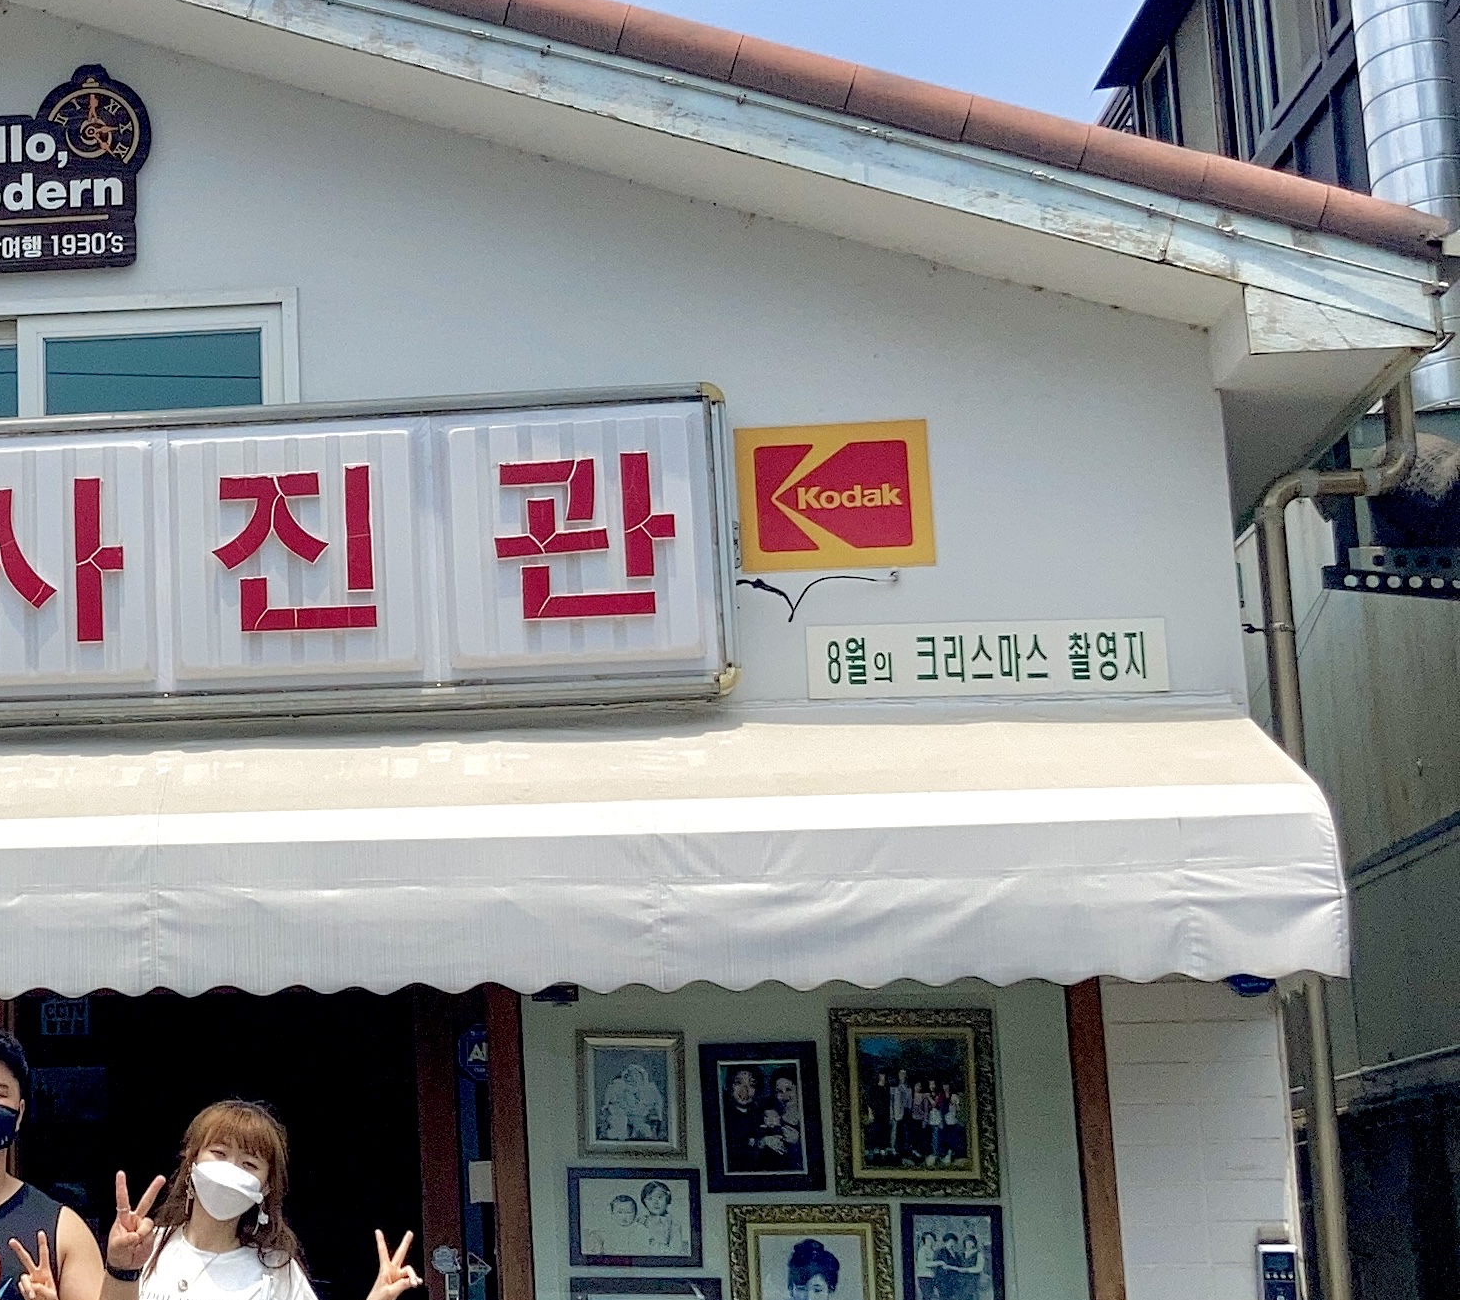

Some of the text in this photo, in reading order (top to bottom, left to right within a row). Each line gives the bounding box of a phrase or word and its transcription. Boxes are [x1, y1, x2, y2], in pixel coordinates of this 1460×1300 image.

[50, 231, 124, 257] 1930's
[796, 482, 903, 511] Kodak
[826, 631, 1148, 686] 8월의 크리스마스 촬영지
